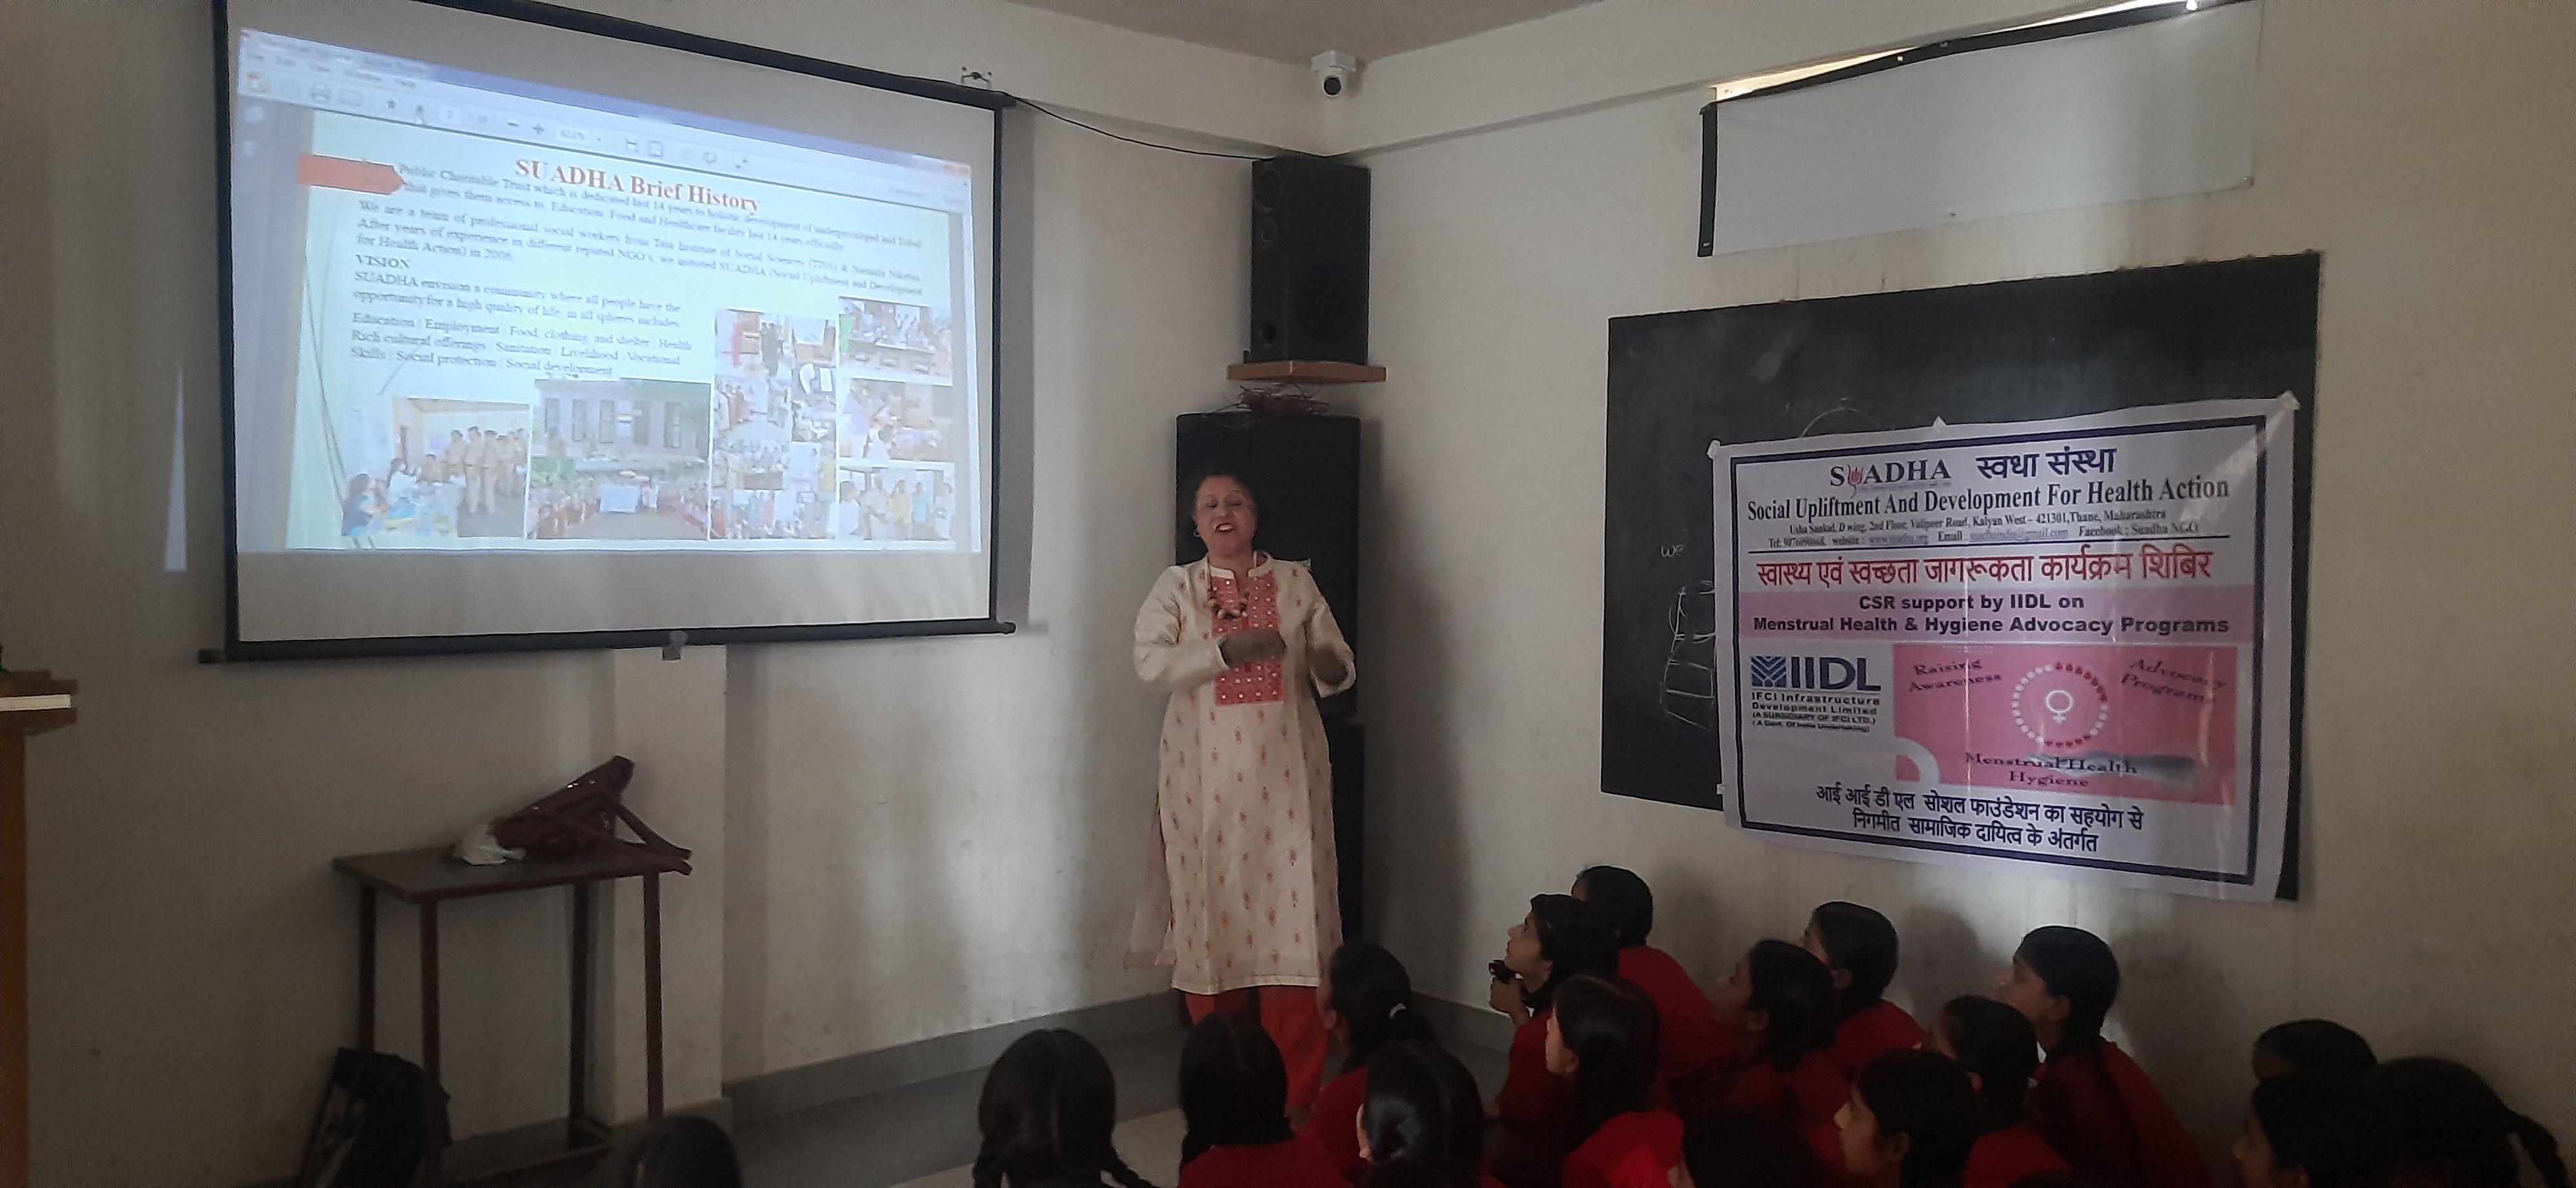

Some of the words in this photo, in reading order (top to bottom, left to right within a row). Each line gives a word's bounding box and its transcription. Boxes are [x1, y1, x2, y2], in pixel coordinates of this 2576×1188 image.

[515, 157, 624, 191] SUADHA
[630, 175, 683, 200] Brief
[688, 184, 759, 215] History
[355, 254, 410, 269] VISION
[354, 271, 418, 287] SUADHA
[484, 285, 545, 300] community
[550, 291, 582, 302] where
[603, 296, 635, 311] people
[639, 300, 662, 310] have
[665, 302, 679, 312] the
[426, 295, 443, 306] for
[456, 297, 482, 312] high
[486, 300, 522, 316] quality
[353, 312, 414, 327] Education
[424, 318, 498, 338] Employment
[594, 333, 612, 343] and
[659, 338, 691, 350] Health
[353, 330, 379, 342] Rich
[384, 332, 430, 346] cultural
[435, 336, 486, 352] offerings
[561, 347, 618, 360] Livelihood
[627, 352, 679, 365] Vocational
[395, 349, 433, 362] Social
[437, 353, 496, 370] protection
[506, 358, 541, 370] Social
[544, 361, 612, 377] development
[1830, 459, 1951, 492] SUADHA
[1976, 454, 2039, 479] स्वधा
[2046, 446, 2117, 475] संस्था
[1748, 499, 1790, 521] Social
[1796, 495, 1880, 523] Upliftment
[1884, 492, 1918, 515] And
[1925, 487, 2040, 516] Development
[2048, 484, 2081, 506] For
[2087, 480, 2152, 504] Health
[2159, 475, 2228, 501] Action
[1839, 522, 1845, 532] D
[1870, 521, 1884, 531] 2nd
[1973, 515, 2002, 530] Kalyan
[2005, 515, 2025, 525] West
[2105, 509, 2166, 521] Maharashtra
[1938, 530, 1962, 542] Email
[2079, 525, 2123, 537] Facebook
[2131, 524, 2168, 535] Suadha
[2172, 522, 2198, 533] NGO
[1756, 560, 1812, 586] स्वास्थ्य
[1816, 556, 1844, 588] एवं
[1848, 559, 1919, 584] स्वच्छता
[1924, 556, 2034, 582] जागरूकता
[2039, 544, 2132, 581] कार्यक्रम
[2139, 543, 2213, 579] शिबिर
[1859, 596, 1895, 609] CSR
[1901, 595, 1975, 613] support
[1981, 595, 2003, 613] by
[2010, 594, 2051, 609] IIDL
[2058, 597, 2084, 609] on
[1754, 617, 1833, 631] Menstrual
[1841, 617, 1897, 631] Health
[1904, 617, 1918, 631] &
[1925, 617, 2003, 636] Hygiene
[2010, 617, 2114, 636] Advocacy
[2121, 617, 2230, 635] Programs
[1791, 656, 1881, 691] IIDL
[1914, 659, 1982, 675] Raising
[2130, 660, 2226, 690] Advocacy
[1909, 675, 2002, 692] Awareness
[1752, 692, 1777, 700] IFCI
[1782, 693, 1880, 705] Infrastructure
[1752, 702, 1826, 713] Development
[1831, 705, 1877, 715] Limited
[1965, 752, 2063, 769] Menstrual
[2067, 758, 2137, 774] Health
[2009, 771, 2088, 786] Hygiene
[1816, 782, 1841, 805] आई
[1845, 784, 1870, 806] आई
[1873, 787, 1891, 808] डी
[1894, 792, 1915, 810] एल
[1924, 789, 1965, 814] सोशल
[1970, 795, 2040, 822] फाउंडेशन
[2044, 805, 2065, 824] का
[2070, 803, 2124, 830] सहयोग
[2128, 805, 2144, 830] से
[1852, 807, 1900, 832] निगमीत
[1908, 814, 1971, 839] सामाजिक
[1975, 819, 2022, 845] दायित्व
[2027, 823, 2042, 846] के
[2048, 827, 2098, 852] अंतर्गत
